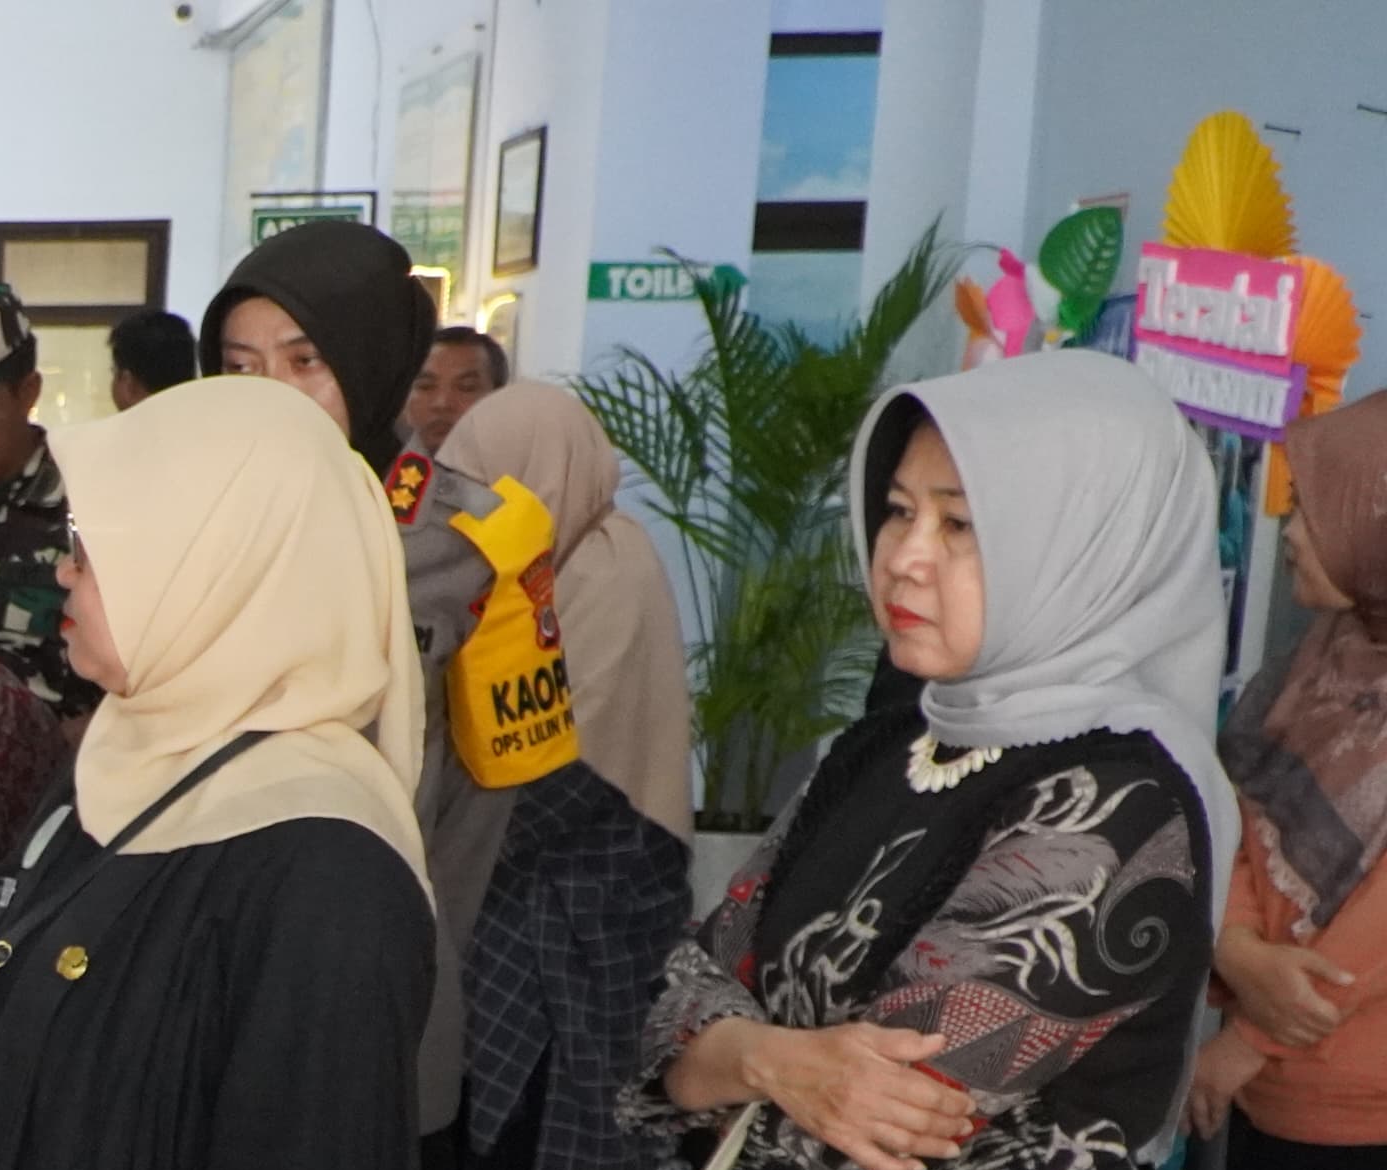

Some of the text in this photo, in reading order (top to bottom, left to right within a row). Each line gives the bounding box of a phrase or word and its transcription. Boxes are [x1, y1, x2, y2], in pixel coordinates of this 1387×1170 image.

[1138, 257, 1296, 357] Teratai
[491, 655, 572, 729] KAOP
[491, 730, 524, 757] OPS
[526, 714, 563, 747] LILIN
